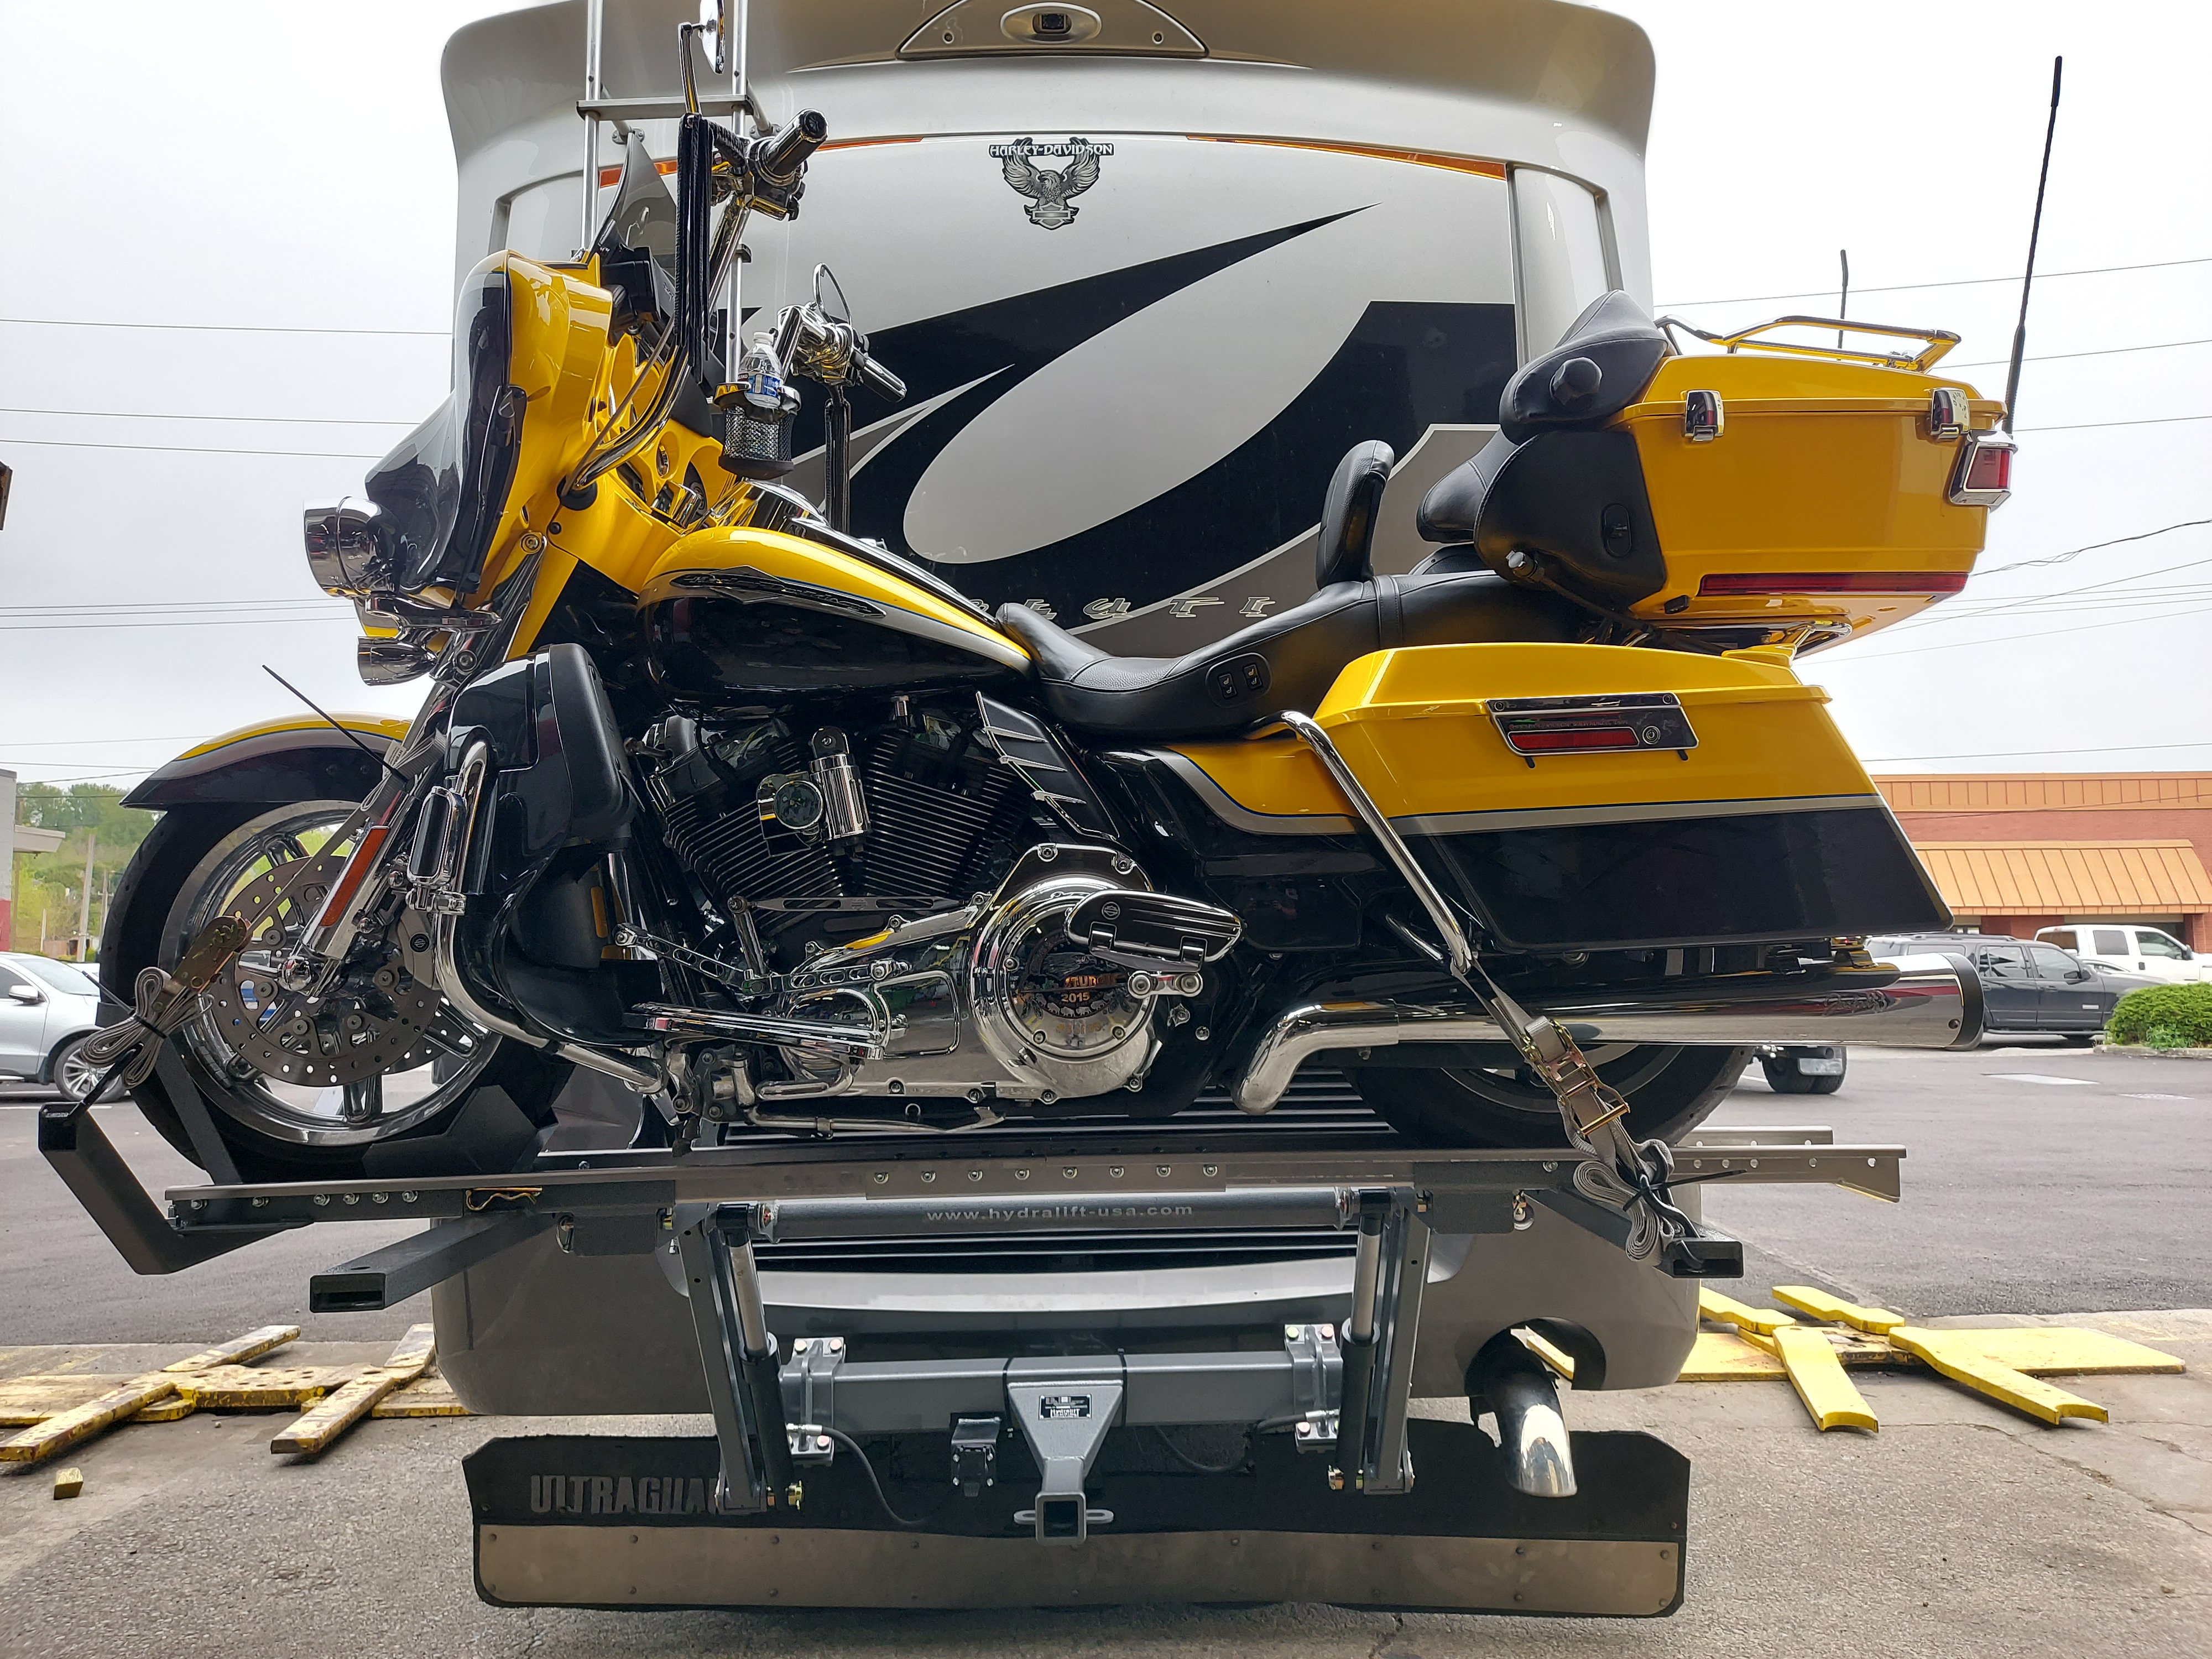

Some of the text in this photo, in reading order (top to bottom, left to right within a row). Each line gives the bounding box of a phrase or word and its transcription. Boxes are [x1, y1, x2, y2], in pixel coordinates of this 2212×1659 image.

[989, 143, 1113, 156] HARLEY-DAVIDSON
[1061, 992, 1091, 1003] 2015
[926, 1205, 1193, 1222] www.hydralift-usa.com
